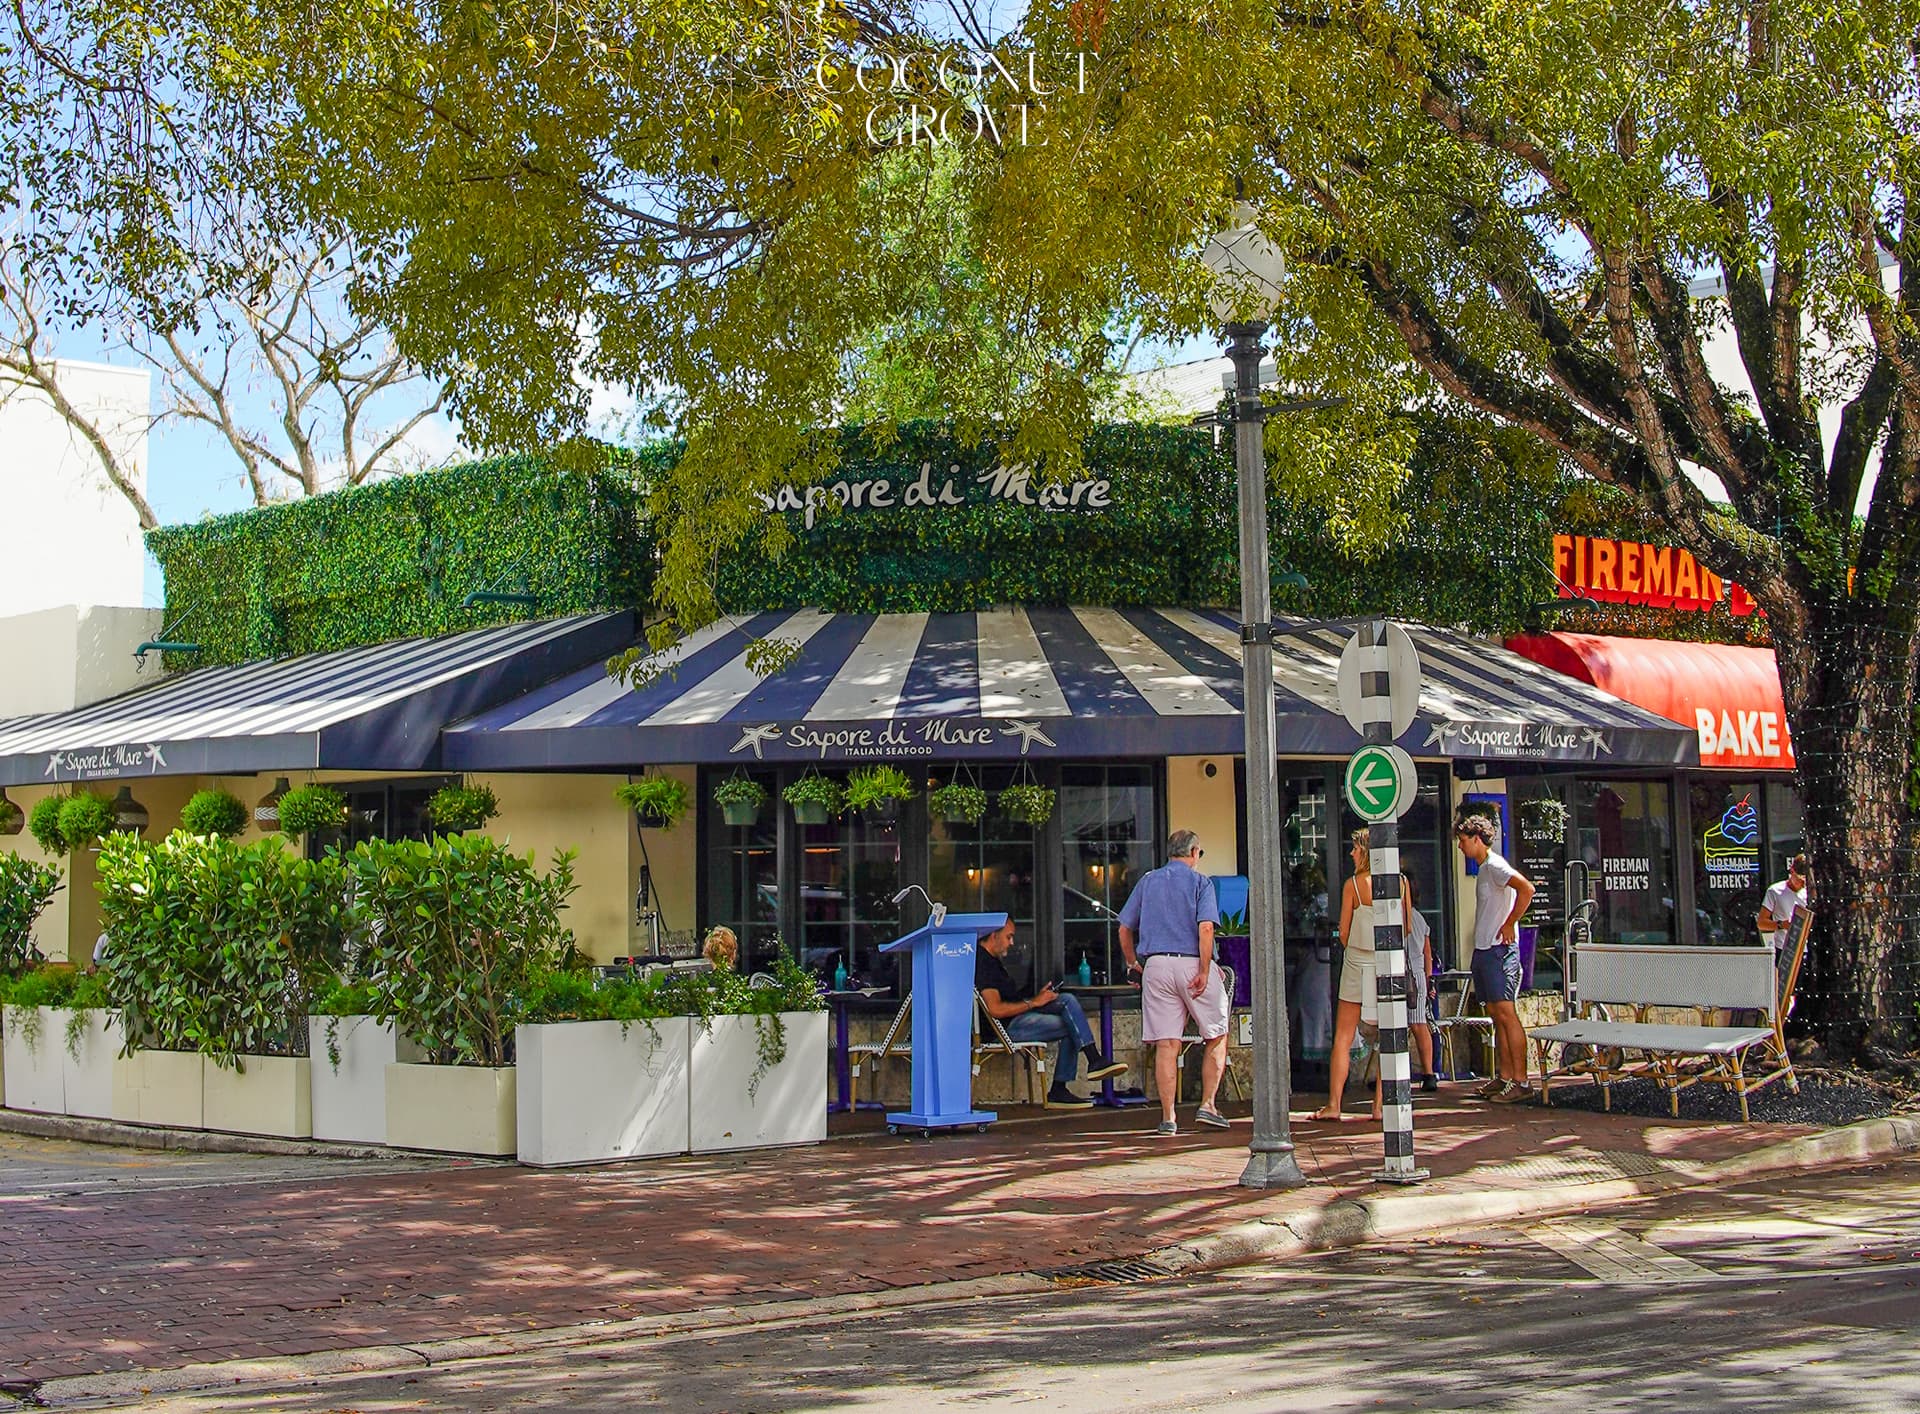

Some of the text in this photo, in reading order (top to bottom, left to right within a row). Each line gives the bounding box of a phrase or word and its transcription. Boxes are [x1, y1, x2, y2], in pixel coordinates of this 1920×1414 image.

[904, 461, 966, 506] di
[976, 461, 1112, 507] Mare
[1552, 534, 1724, 601] FIREMAN
[785, 718, 994, 759] Sapore di Mare
[1459, 723, 1579, 757] Sapore di Mare
[1695, 707, 1780, 757] BAKE
[65, 744, 143, 780] Sapore di Mare
[845, 746, 933, 756] ITALIAN SEAFOOD
[1495, 747, 1546, 757] ITALIAN SEAFOOD
[1602, 857, 1650, 873] FIREMAN
[1707, 857, 1750, 872] FIREMAN
[1605, 875, 1649, 890] DEREK'S
[1709, 874, 1750, 889] DEREK'S
